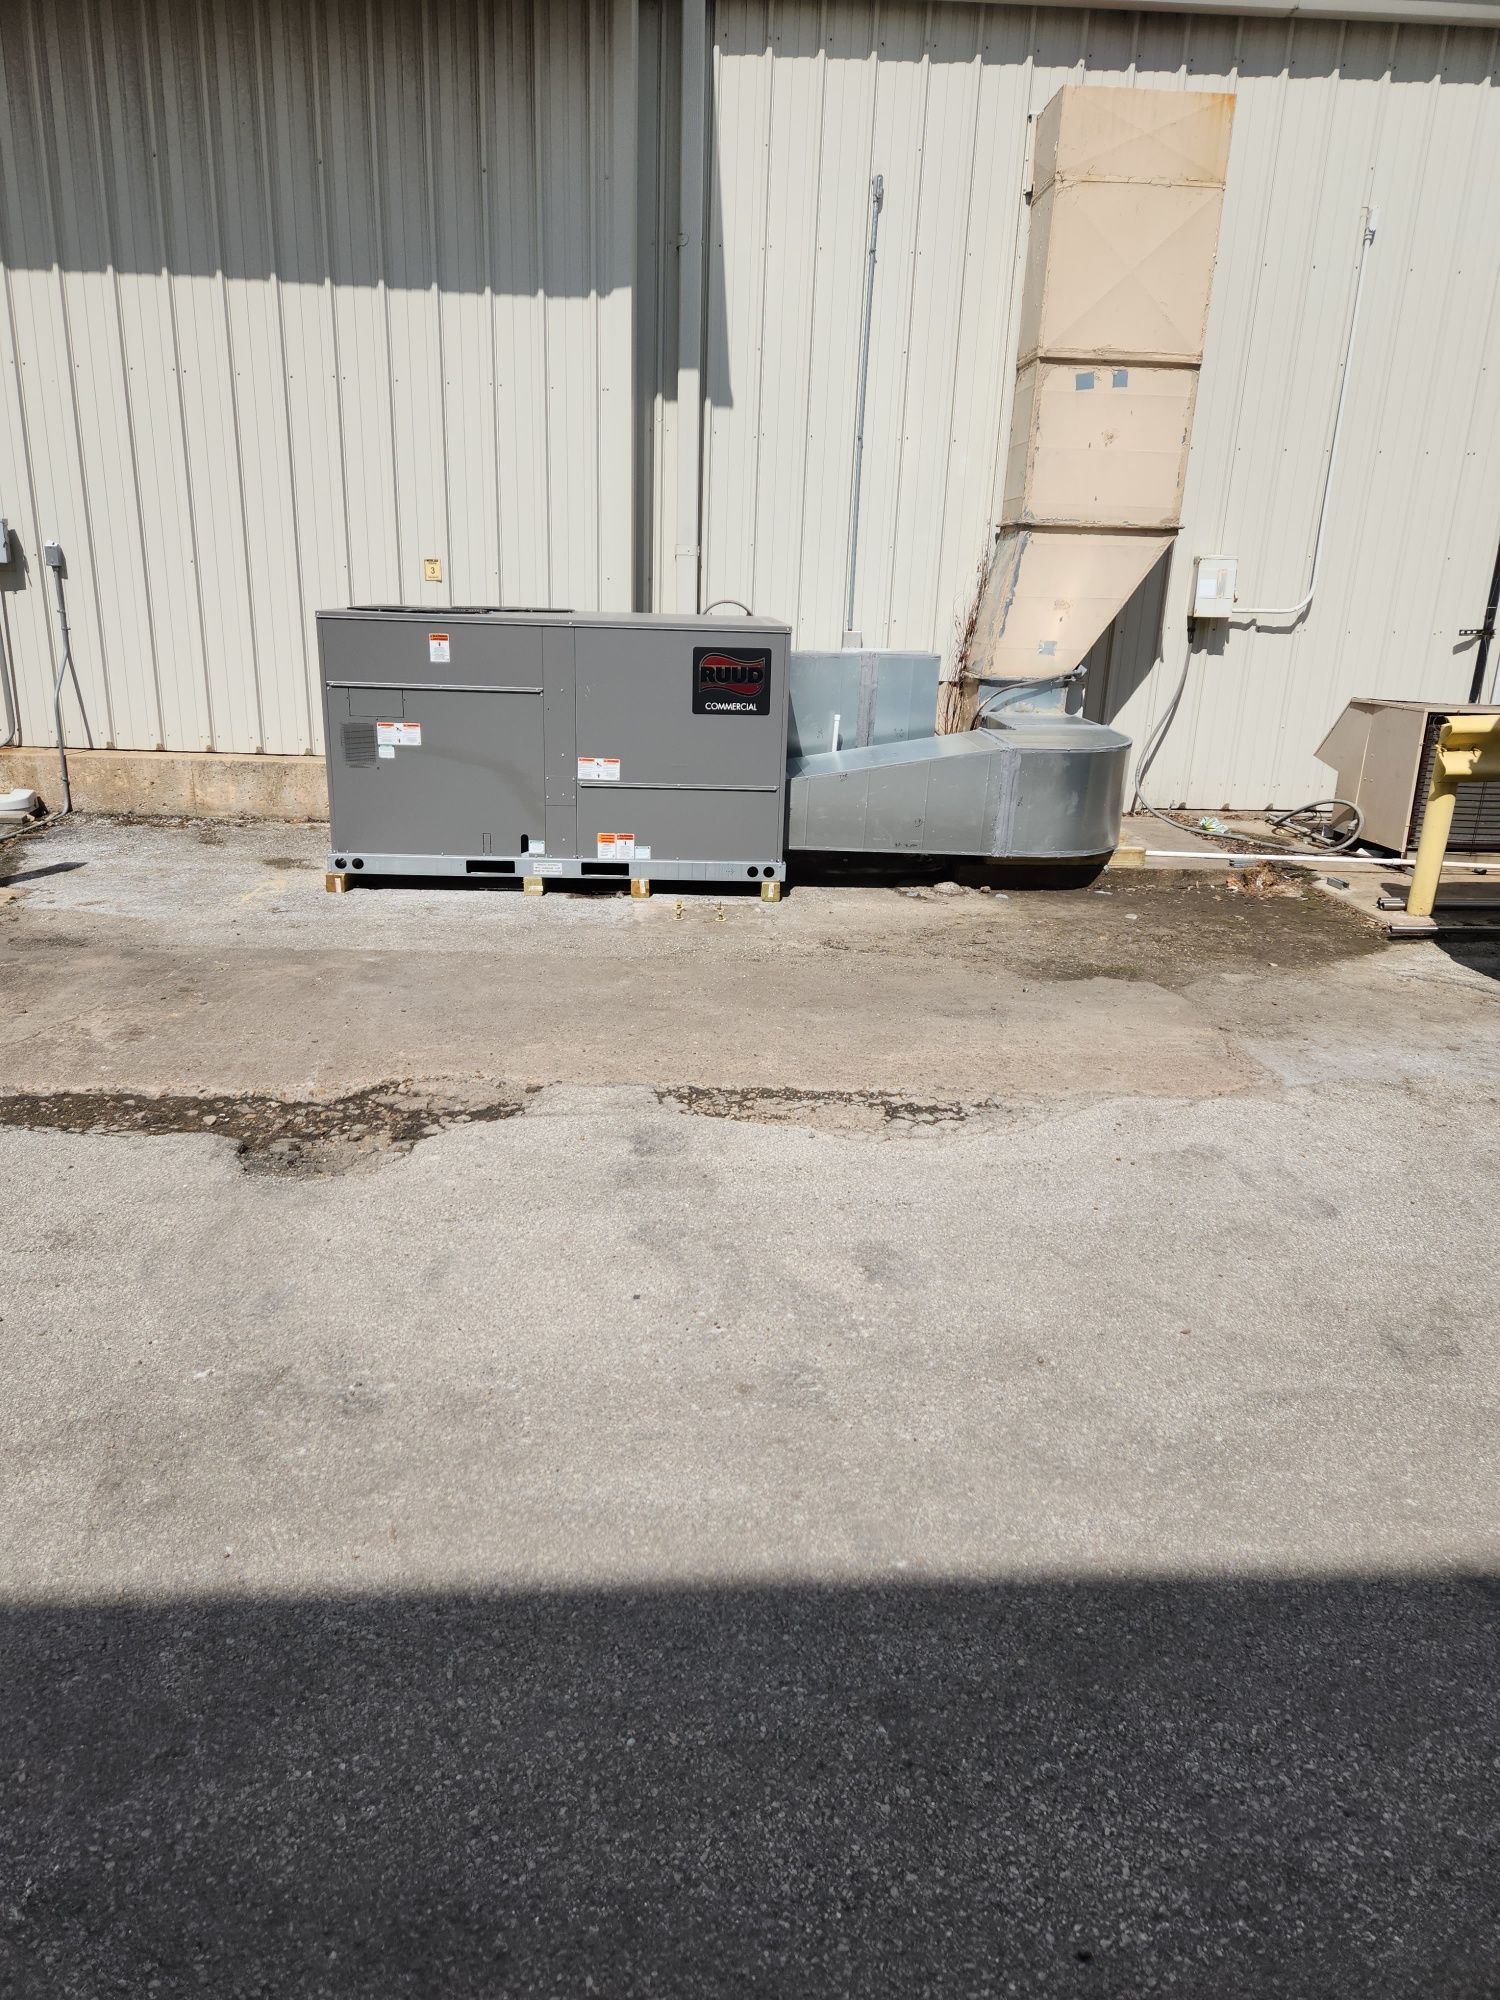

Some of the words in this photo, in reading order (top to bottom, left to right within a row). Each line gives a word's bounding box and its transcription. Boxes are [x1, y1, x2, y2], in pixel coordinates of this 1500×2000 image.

[430, 566, 436, 574] 3
[700, 666, 764, 683] RUUD
[705, 702, 757, 711] COMMERCIAL
